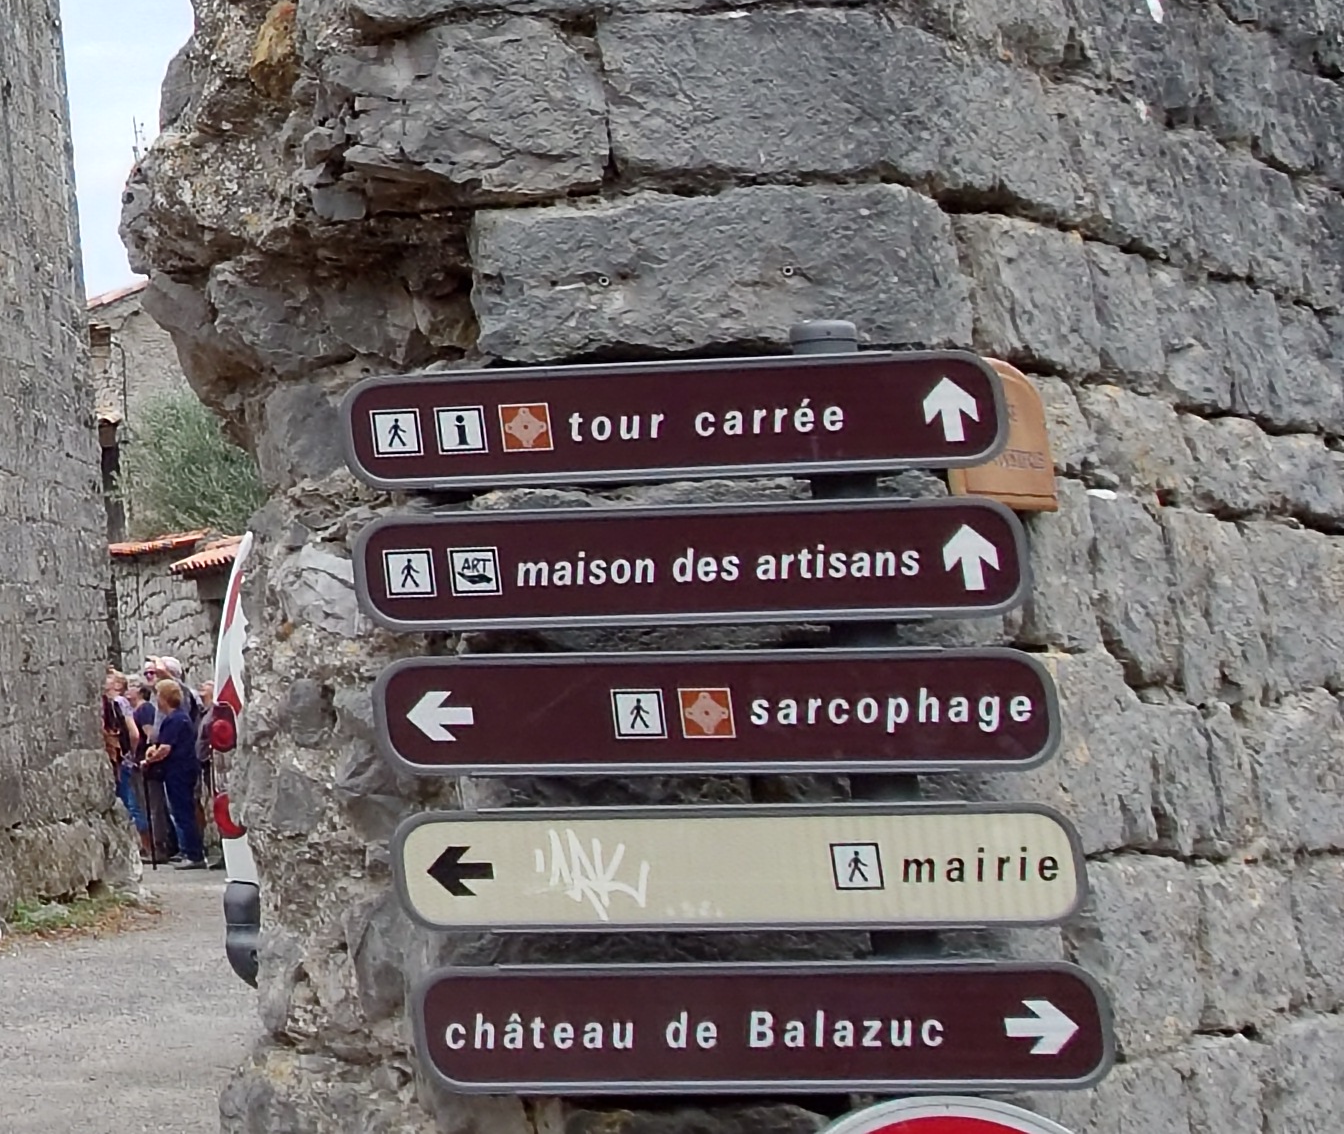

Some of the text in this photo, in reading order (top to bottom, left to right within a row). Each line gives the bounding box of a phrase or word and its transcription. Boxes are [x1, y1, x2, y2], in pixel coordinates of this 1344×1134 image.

[568, 398, 844, 442] tour carrée
[461, 557, 492, 573] ART
[516, 543, 920, 587] maison des artisans
[750, 687, 1033, 734] sarcophage
[902, 845, 1059, 883] mairie
[444, 1009, 944, 1050] château de Balazuc
